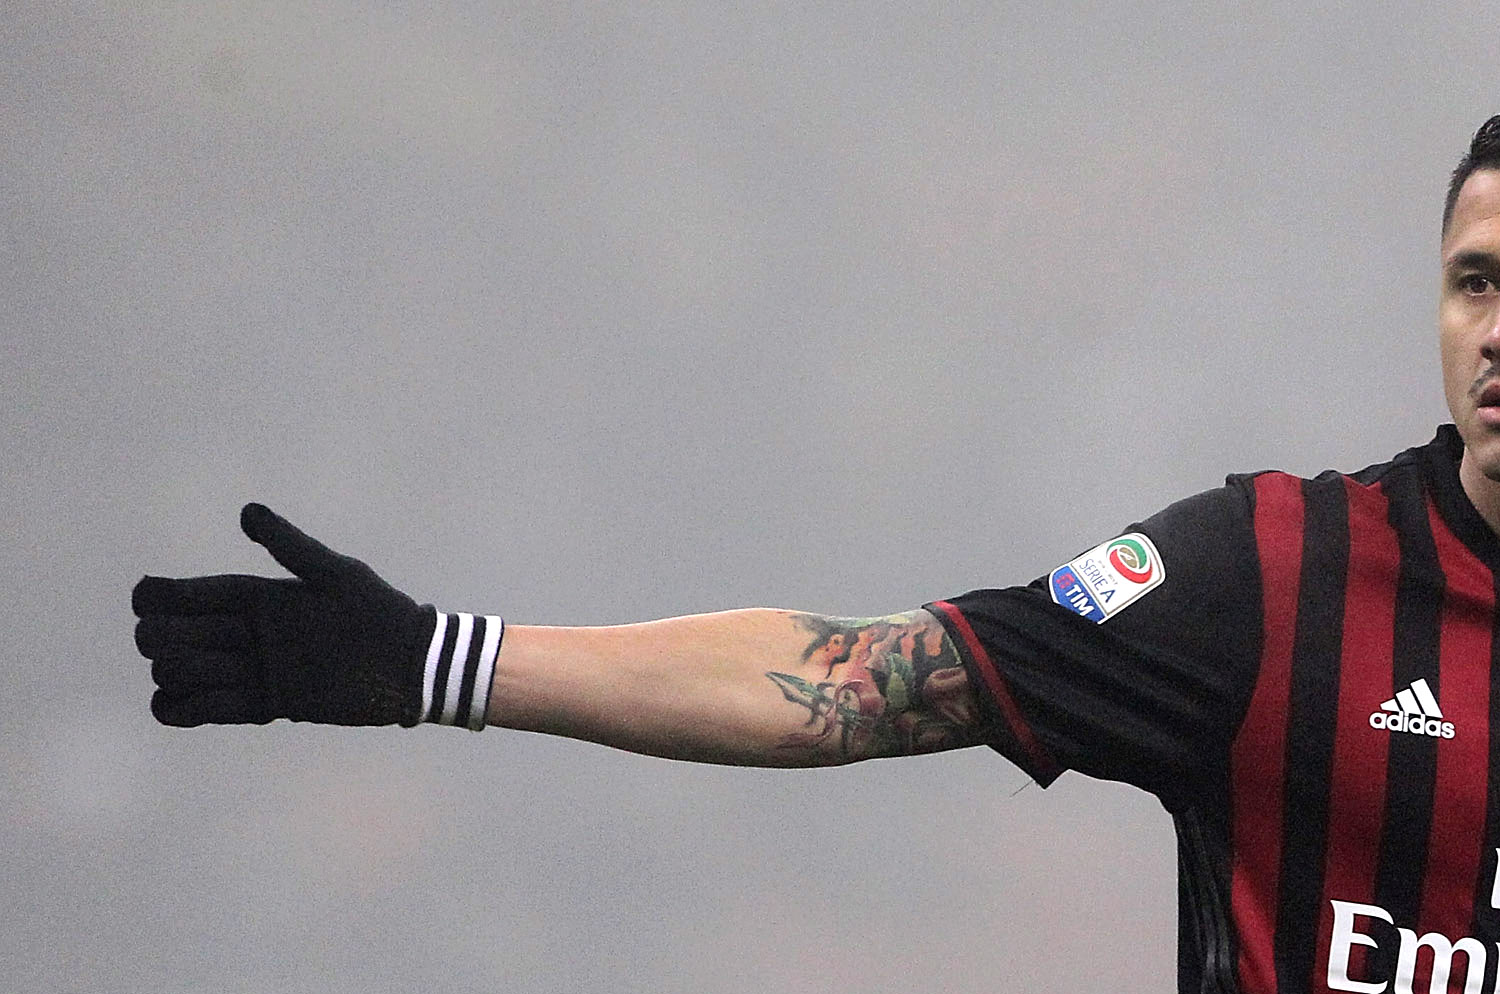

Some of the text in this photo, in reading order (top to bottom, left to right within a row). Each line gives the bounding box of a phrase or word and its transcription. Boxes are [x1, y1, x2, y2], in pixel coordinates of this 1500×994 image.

[1079, 559, 1108, 591] SERIE
[1100, 589, 1116, 603] A
[1066, 585, 1094, 616] TIM
[1369, 710, 1456, 739] adidas
